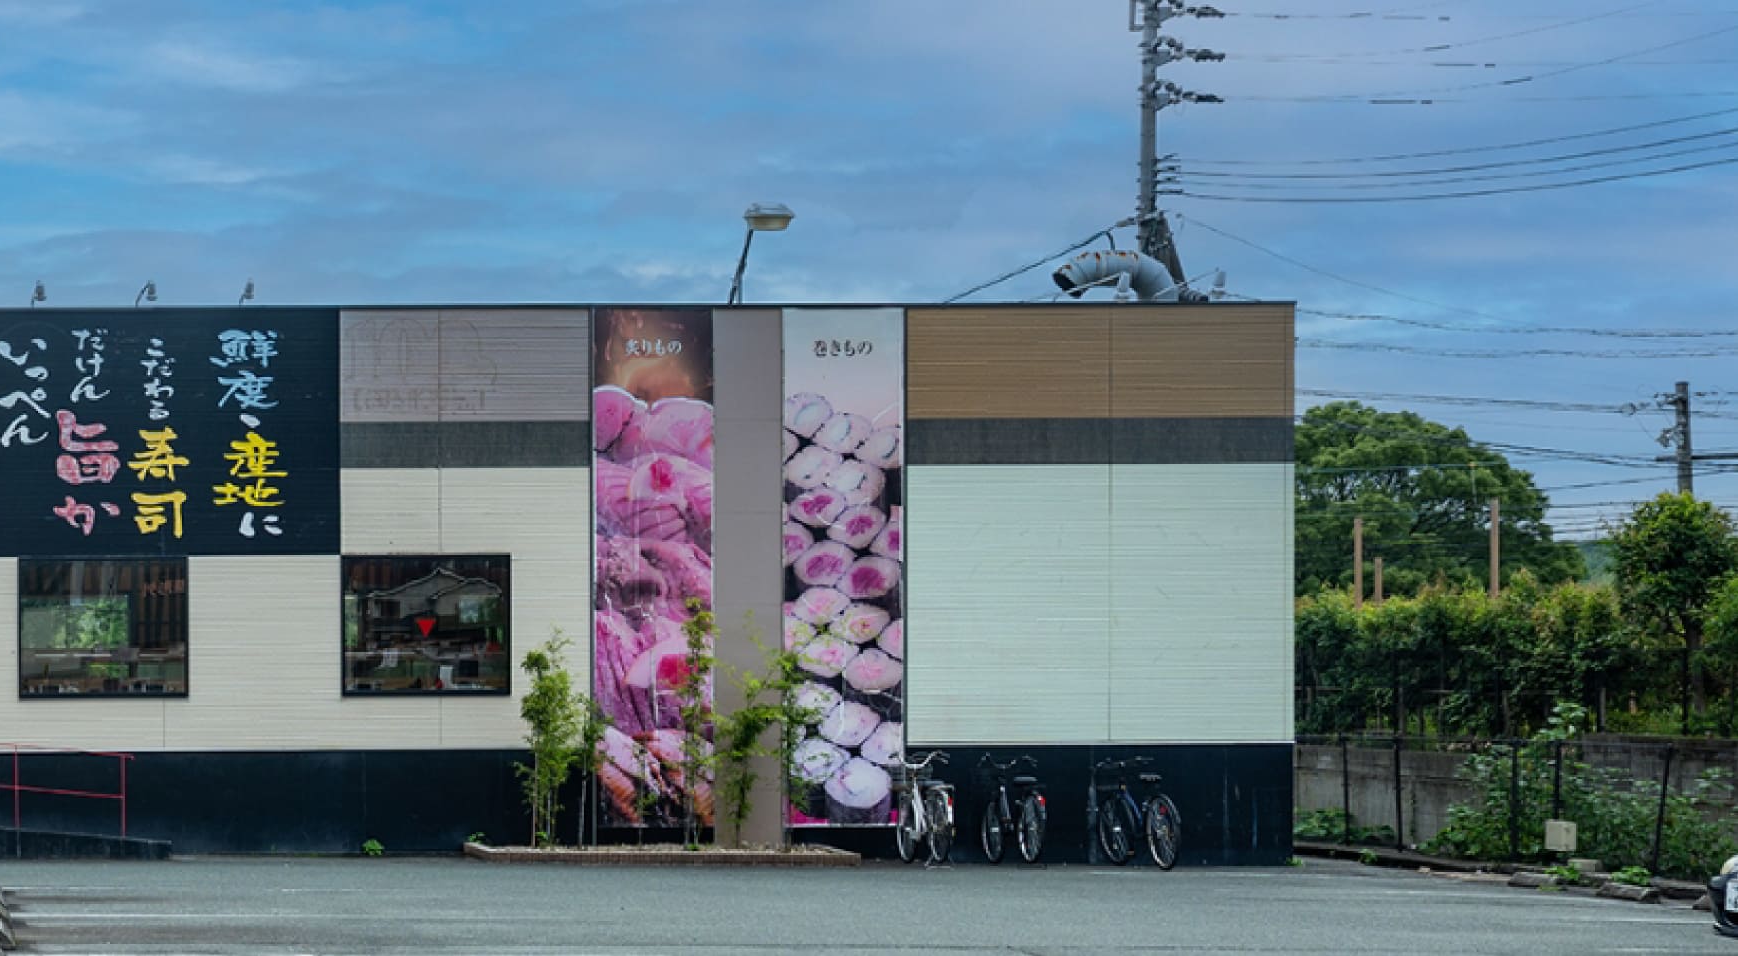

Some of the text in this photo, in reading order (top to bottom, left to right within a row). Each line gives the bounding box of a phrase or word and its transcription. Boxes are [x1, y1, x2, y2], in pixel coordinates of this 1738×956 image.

[624, 337, 683, 357] 炙りもの
[812, 338, 873, 358] 巻きもの
[52, 328, 121, 536] だけん旨か
[126, 337, 191, 539] こだわる寿司
